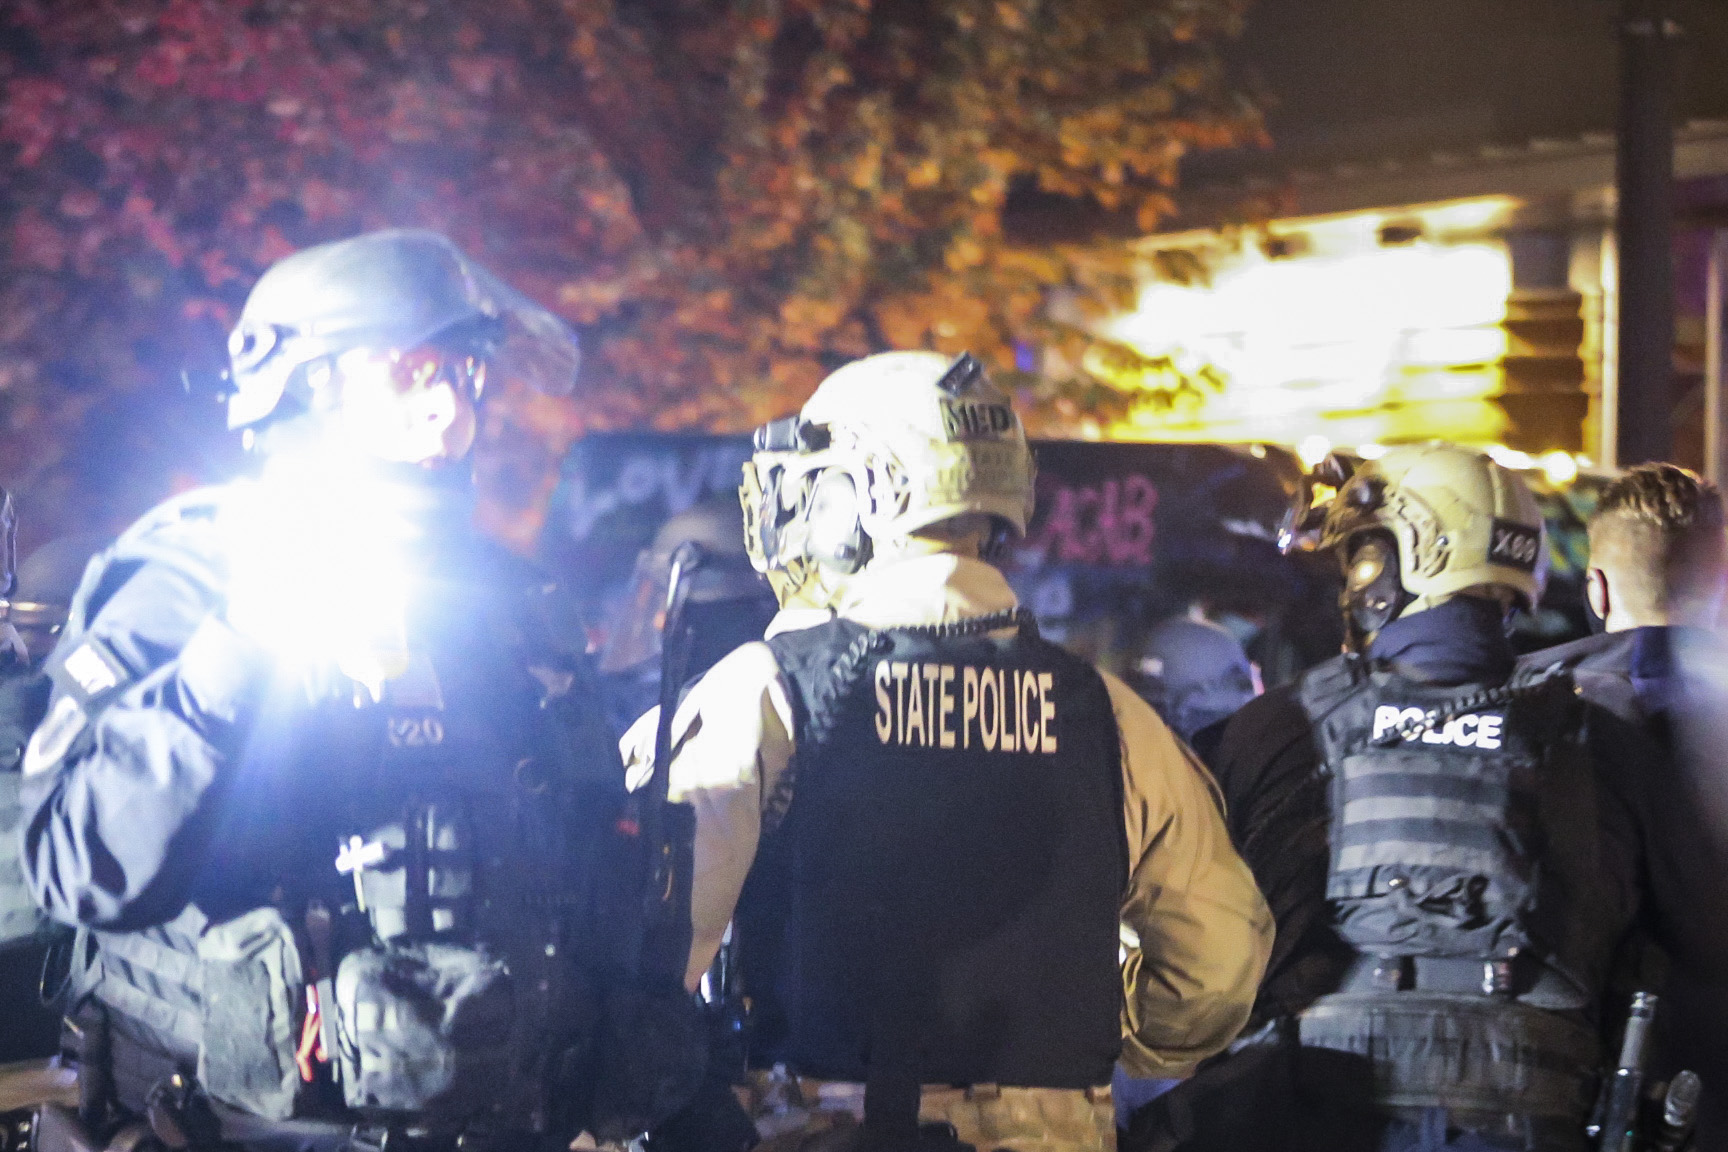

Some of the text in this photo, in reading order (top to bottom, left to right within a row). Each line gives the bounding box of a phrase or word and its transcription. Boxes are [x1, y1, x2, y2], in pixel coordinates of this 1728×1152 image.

[874, 659, 1058, 754] STATE POLICE
[1373, 705, 1503, 749] POLICE
